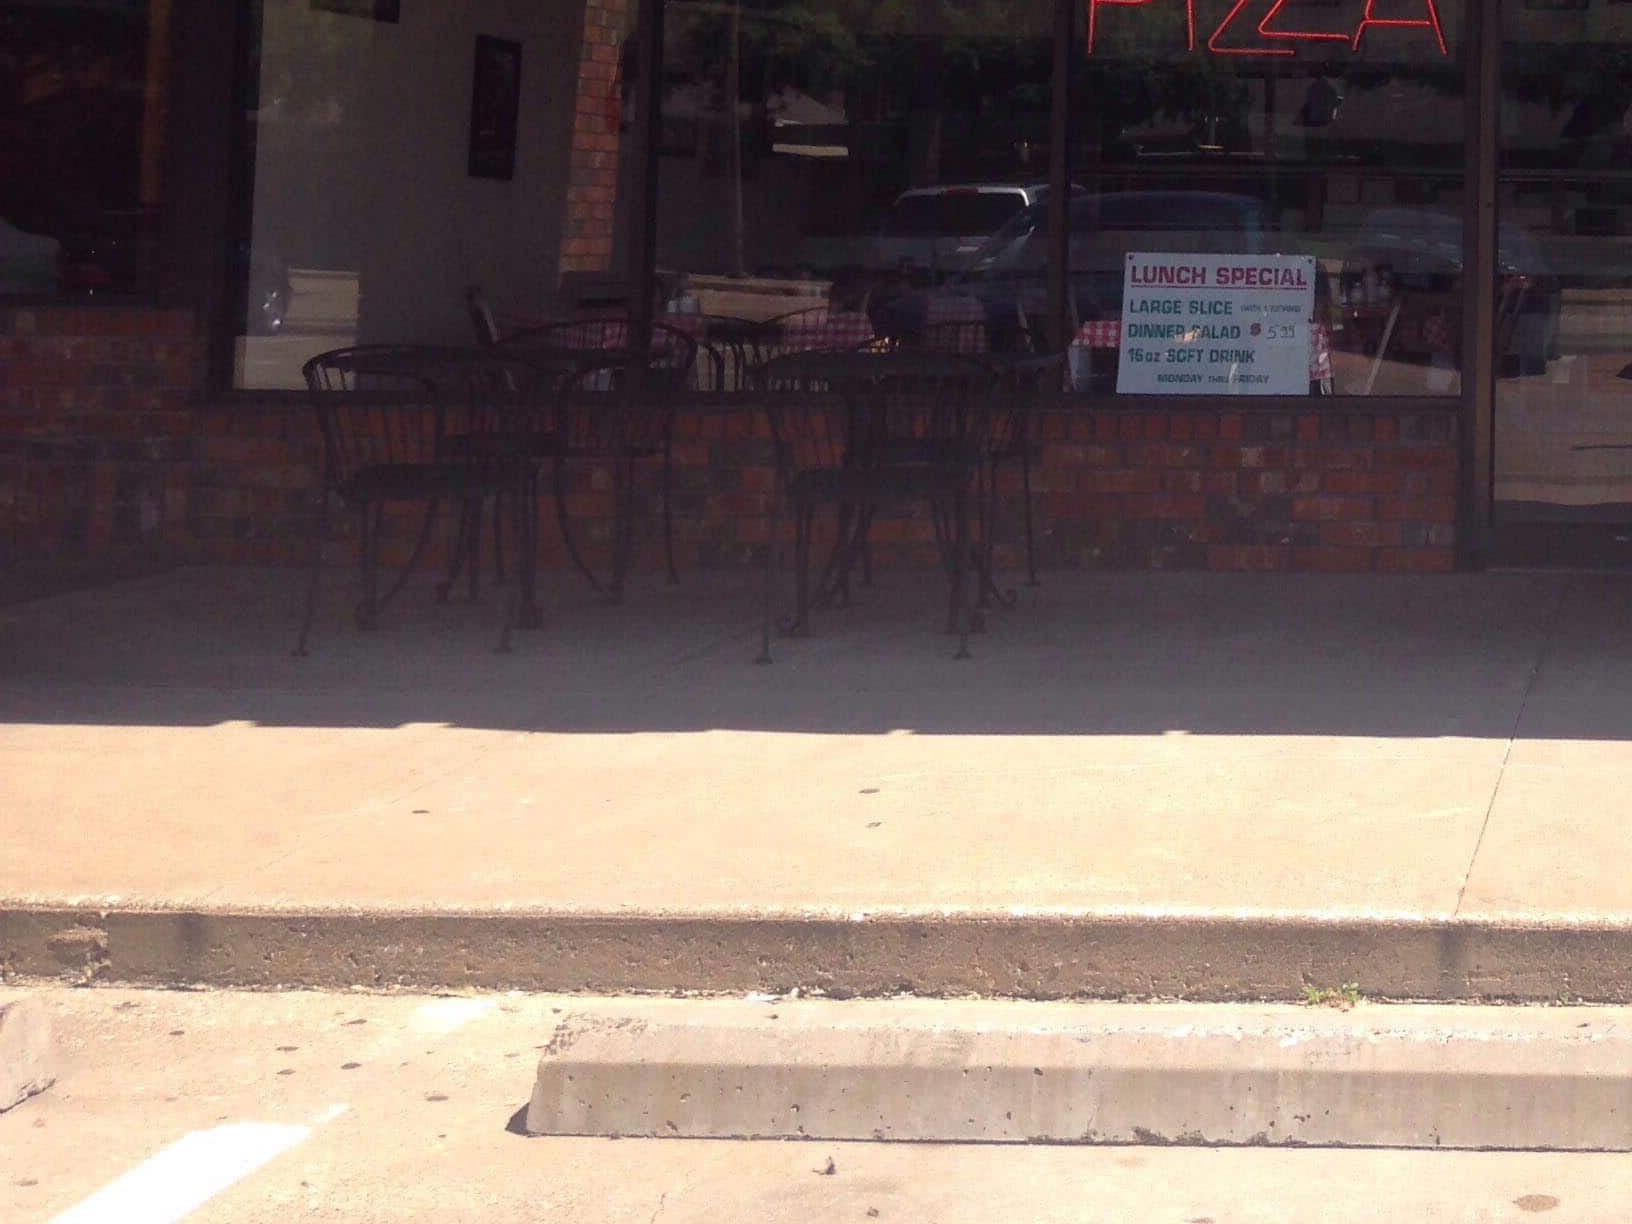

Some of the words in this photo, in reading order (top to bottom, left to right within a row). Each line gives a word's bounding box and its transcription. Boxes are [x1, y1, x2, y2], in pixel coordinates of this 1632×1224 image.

[1130, 265, 1207, 286] LUNCH
[1216, 267, 1308, 287] SPECIAL
[1129, 299, 1183, 315] LARGE
[1188, 300, 1233, 316] SLICE
[1128, 323, 1186, 339] DINNER
[1166, 348, 1204, 363] SOFT
[1209, 349, 1256, 364] DRINK
[1157, 374, 1203, 384] MONDAY
